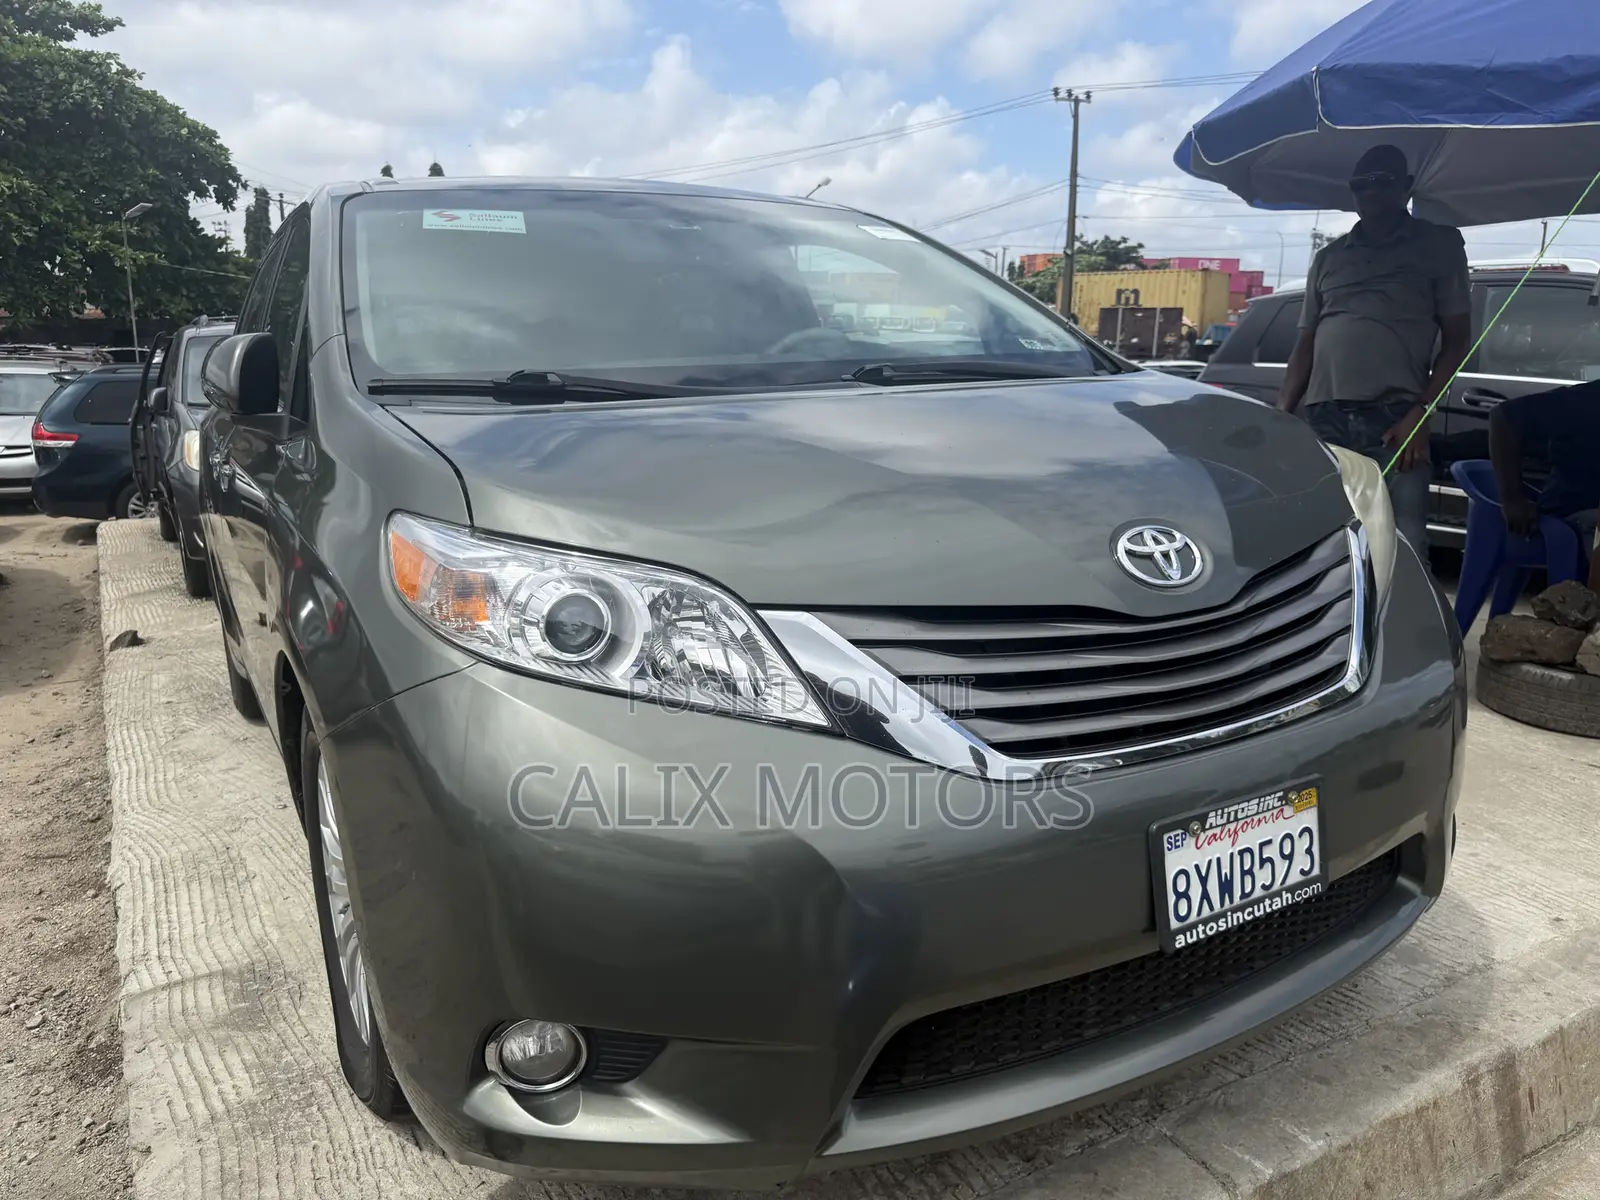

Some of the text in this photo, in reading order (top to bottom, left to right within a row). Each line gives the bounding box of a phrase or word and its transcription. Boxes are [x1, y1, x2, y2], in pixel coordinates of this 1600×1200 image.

[1198, 260, 1220, 270] ONE
[1166, 832, 1188, 851] SEP
[1194, 807, 1295, 850] California
[1171, 826, 1316, 923] 8XWB593
[1174, 882, 1322, 949] autosincutah.com
